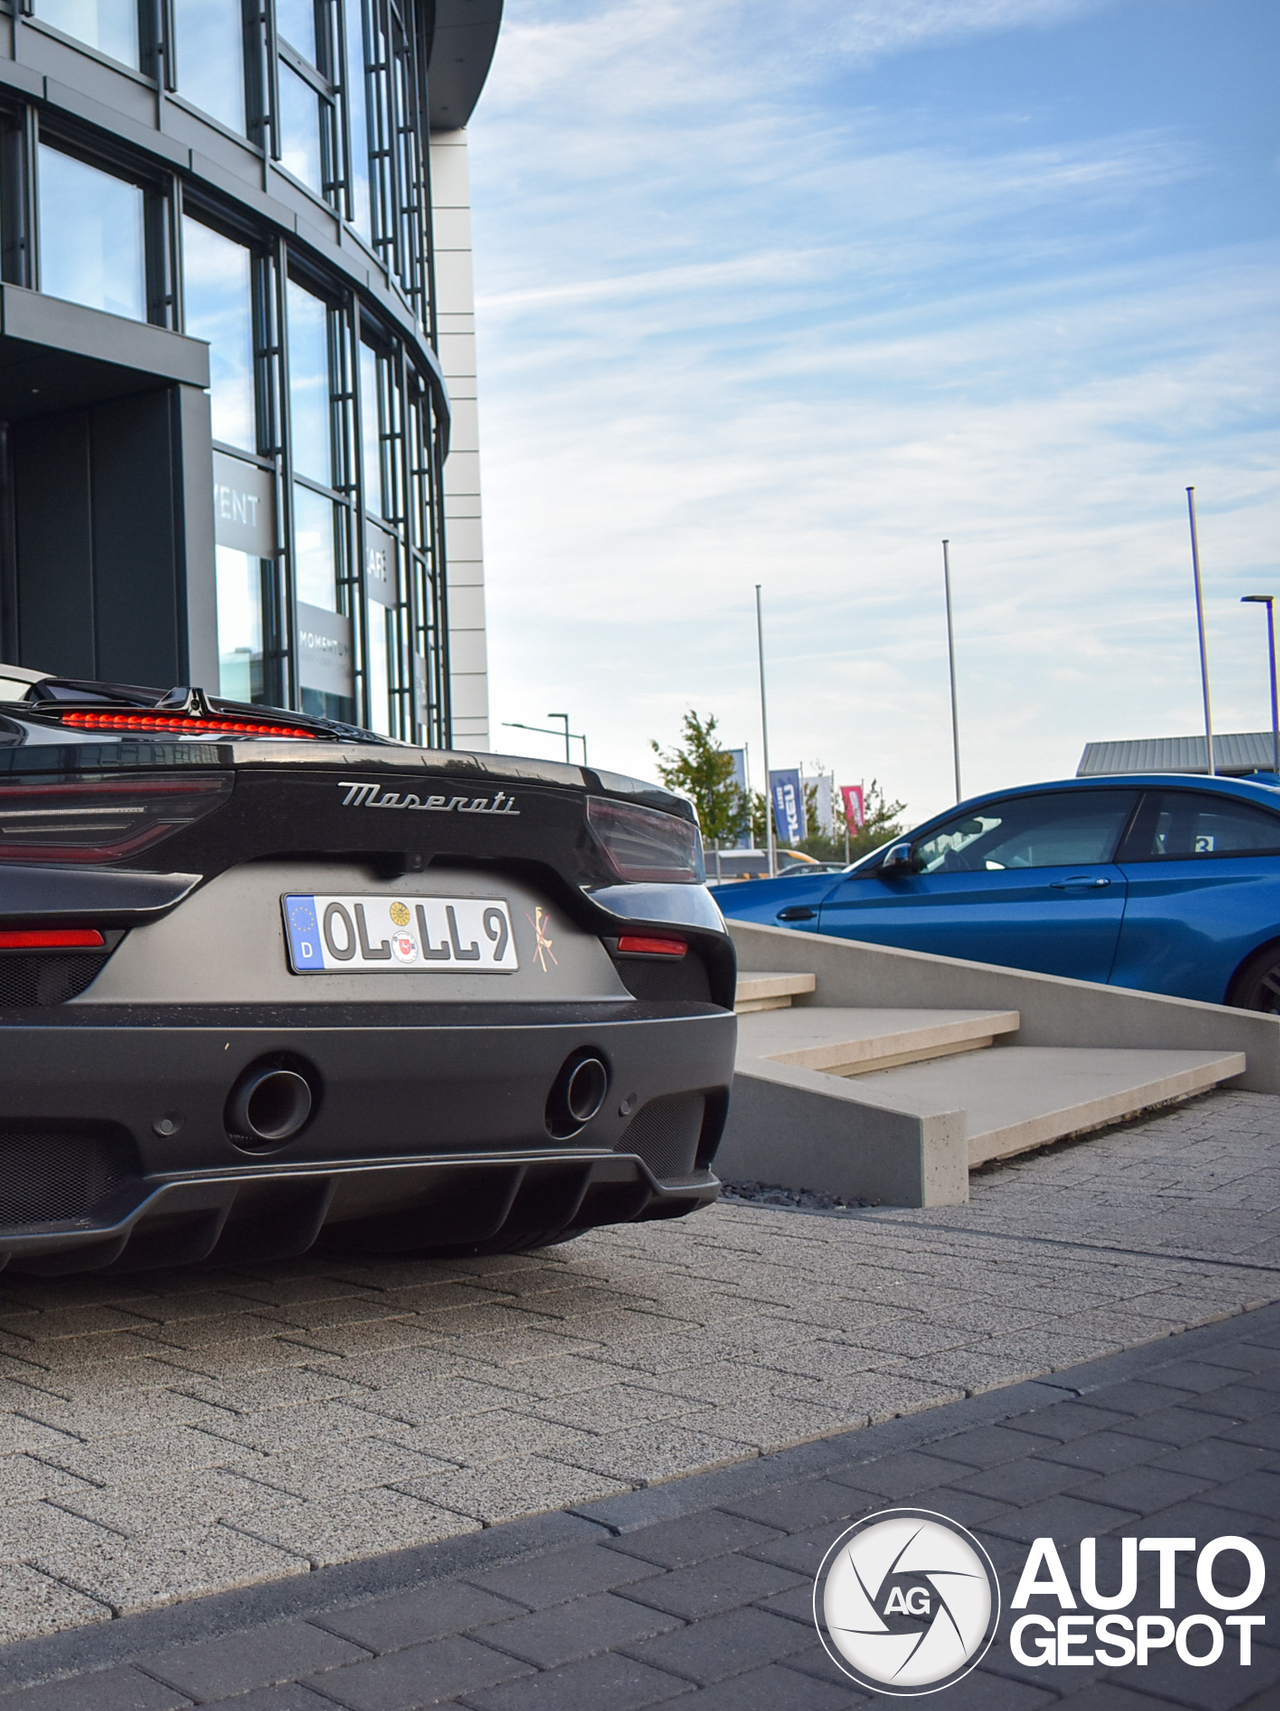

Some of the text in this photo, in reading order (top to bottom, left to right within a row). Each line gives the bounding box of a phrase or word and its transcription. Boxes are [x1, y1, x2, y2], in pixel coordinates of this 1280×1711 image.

[337, 781, 521, 816] Maserati
[323, 901, 392, 961] OL
[415, 904, 480, 961] LL
[482, 907, 509, 961] 9
[301, 941, 314, 959] D
